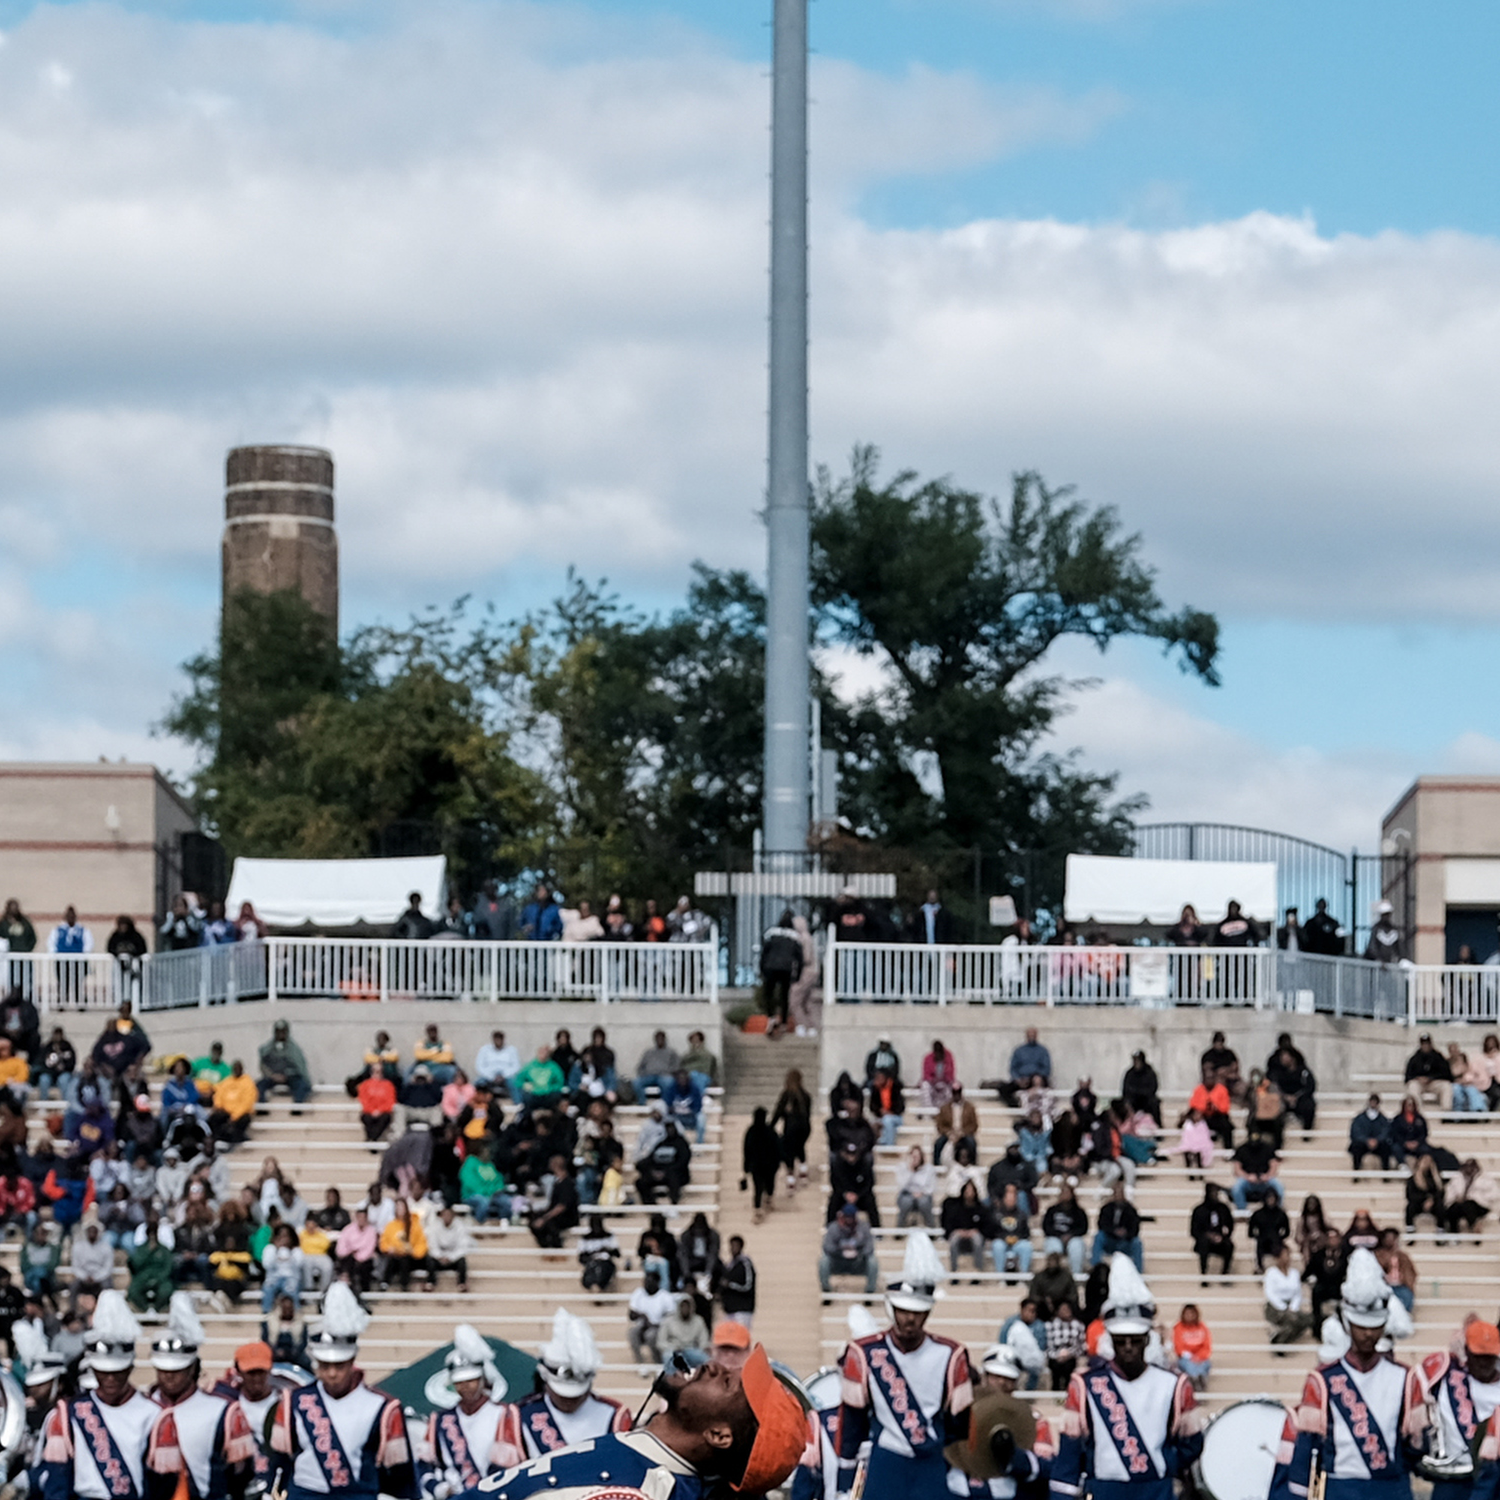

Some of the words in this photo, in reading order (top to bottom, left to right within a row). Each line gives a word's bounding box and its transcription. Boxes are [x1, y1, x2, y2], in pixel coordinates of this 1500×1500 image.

[299, 1393, 349, 1487] MORGAN
[870, 1348, 927, 1445] MORGAN
[1090, 1375, 1149, 1474] MORGAN
[1329, 1374, 1387, 1470] MORGAN
[74, 1401, 130, 1495] MORGAN
